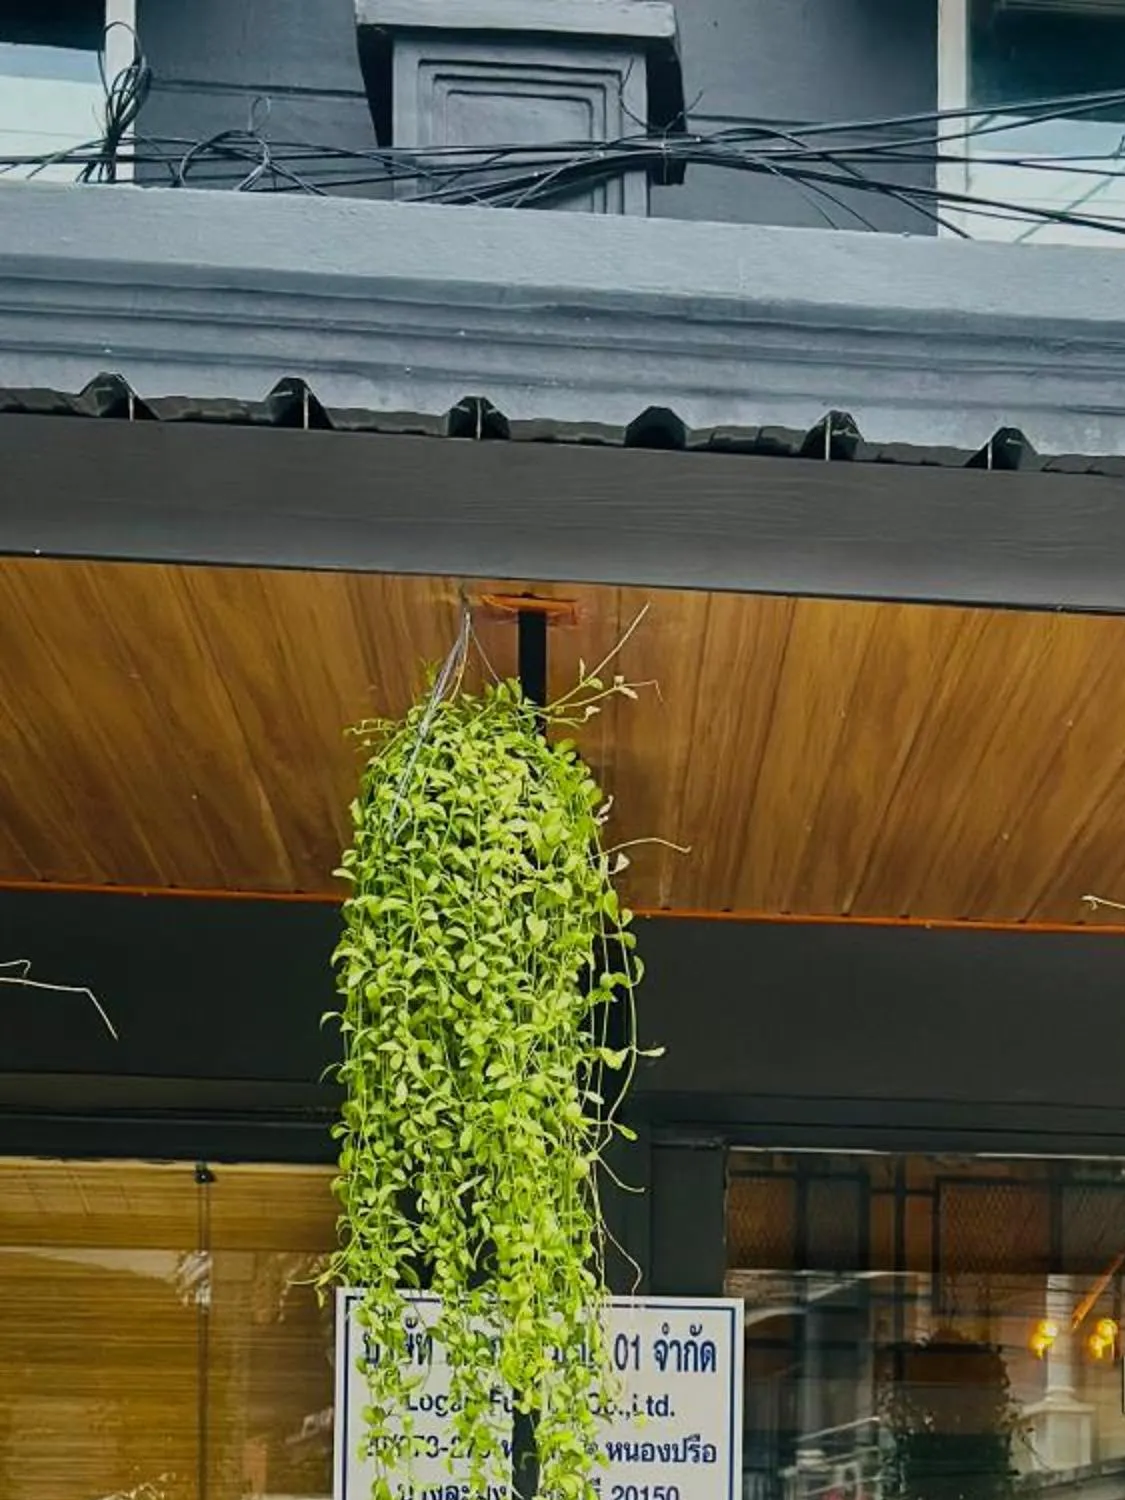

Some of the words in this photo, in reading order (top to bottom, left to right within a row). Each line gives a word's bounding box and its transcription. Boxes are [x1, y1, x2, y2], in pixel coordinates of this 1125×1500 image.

[613, 1333, 641, 1372] 01
[653, 1322, 717, 1373] จำกัด
[605, 1434, 717, 1464] หนองปรือ
